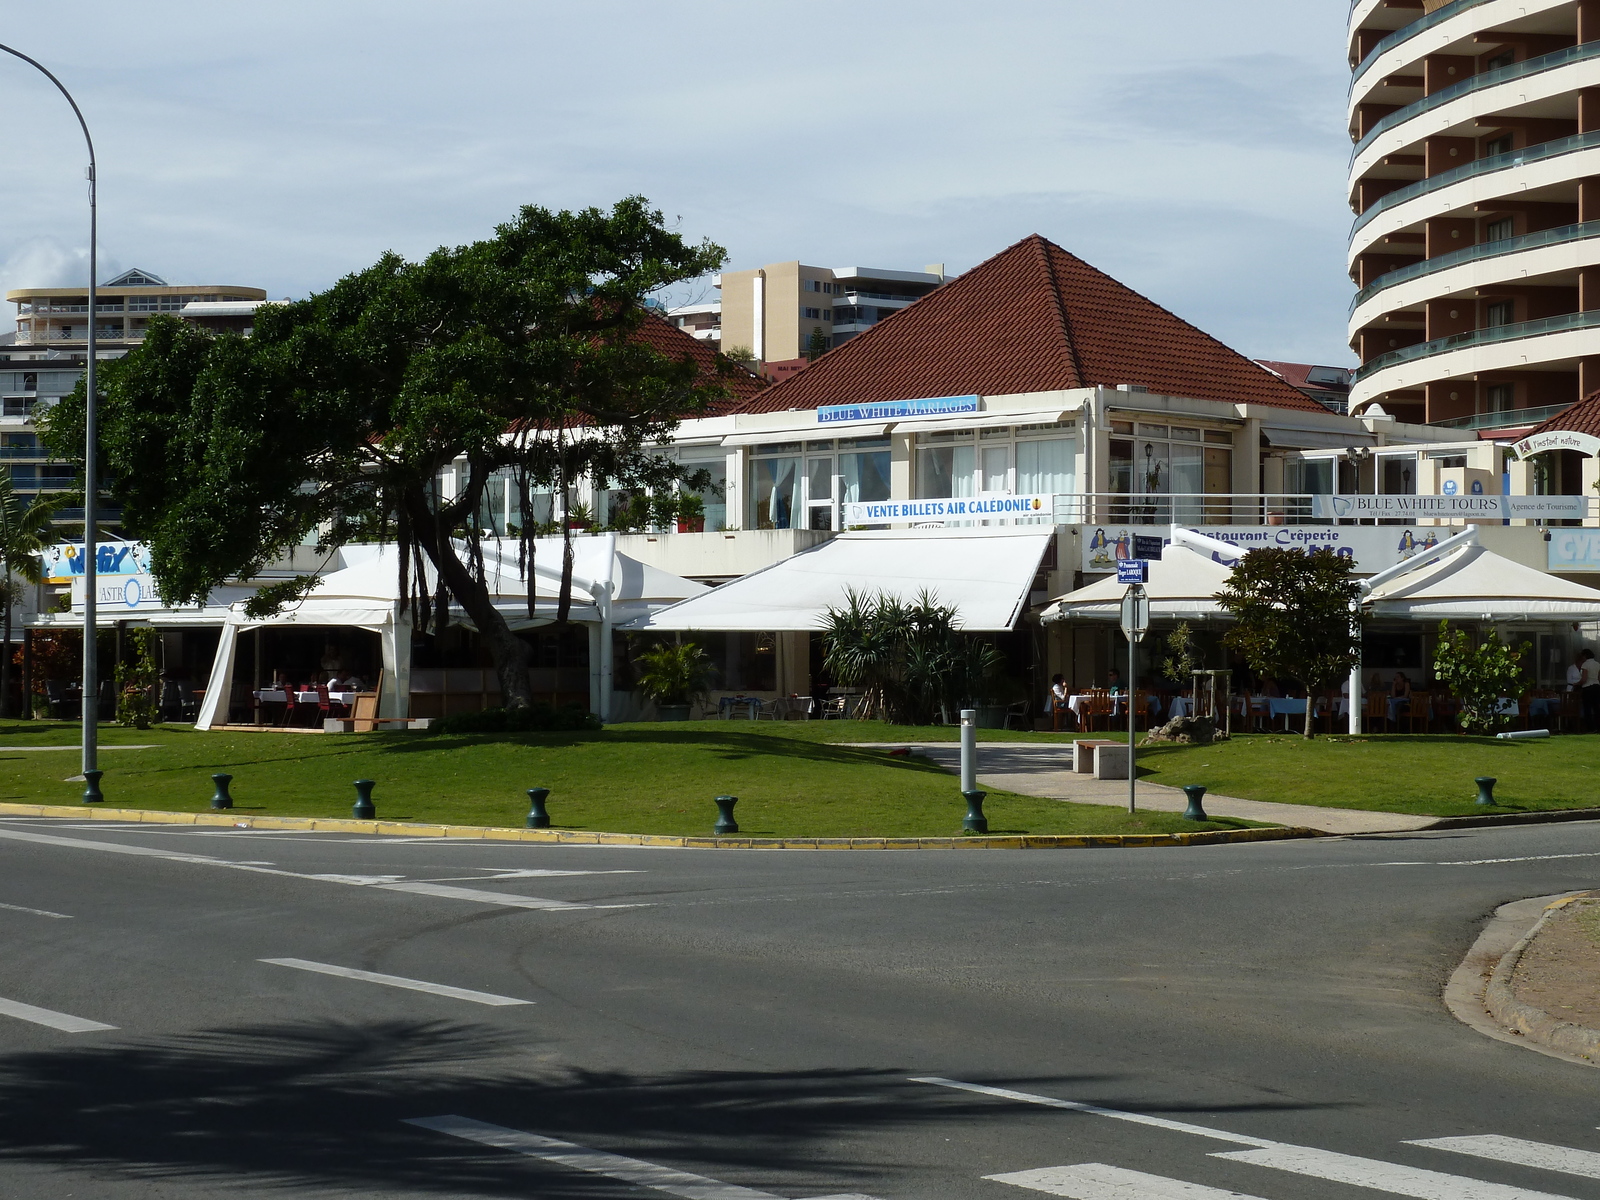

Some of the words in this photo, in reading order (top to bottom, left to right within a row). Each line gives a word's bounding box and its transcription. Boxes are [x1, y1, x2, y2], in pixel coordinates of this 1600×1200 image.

[821, 407, 855, 421] BLUE
[858, 405, 902, 419] WHITE
[905, 399, 973, 416] MARIAGES
[1560, 434, 1581, 447] nature
[866, 505, 899, 518] VENTE
[901, 503, 944, 516] BILLETS
[946, 501, 966, 514] AIR
[968, 497, 1031, 514] CALÉDONIE
[1357, 498, 1394, 510] BLUE
[1397, 498, 1445, 510] WHITE
[1448, 498, 1498, 510] TOURS
[1510, 503, 1536, 512] Agence
[1536, 503, 1544, 511] de
[1546, 503, 1578, 511] Tourisme
